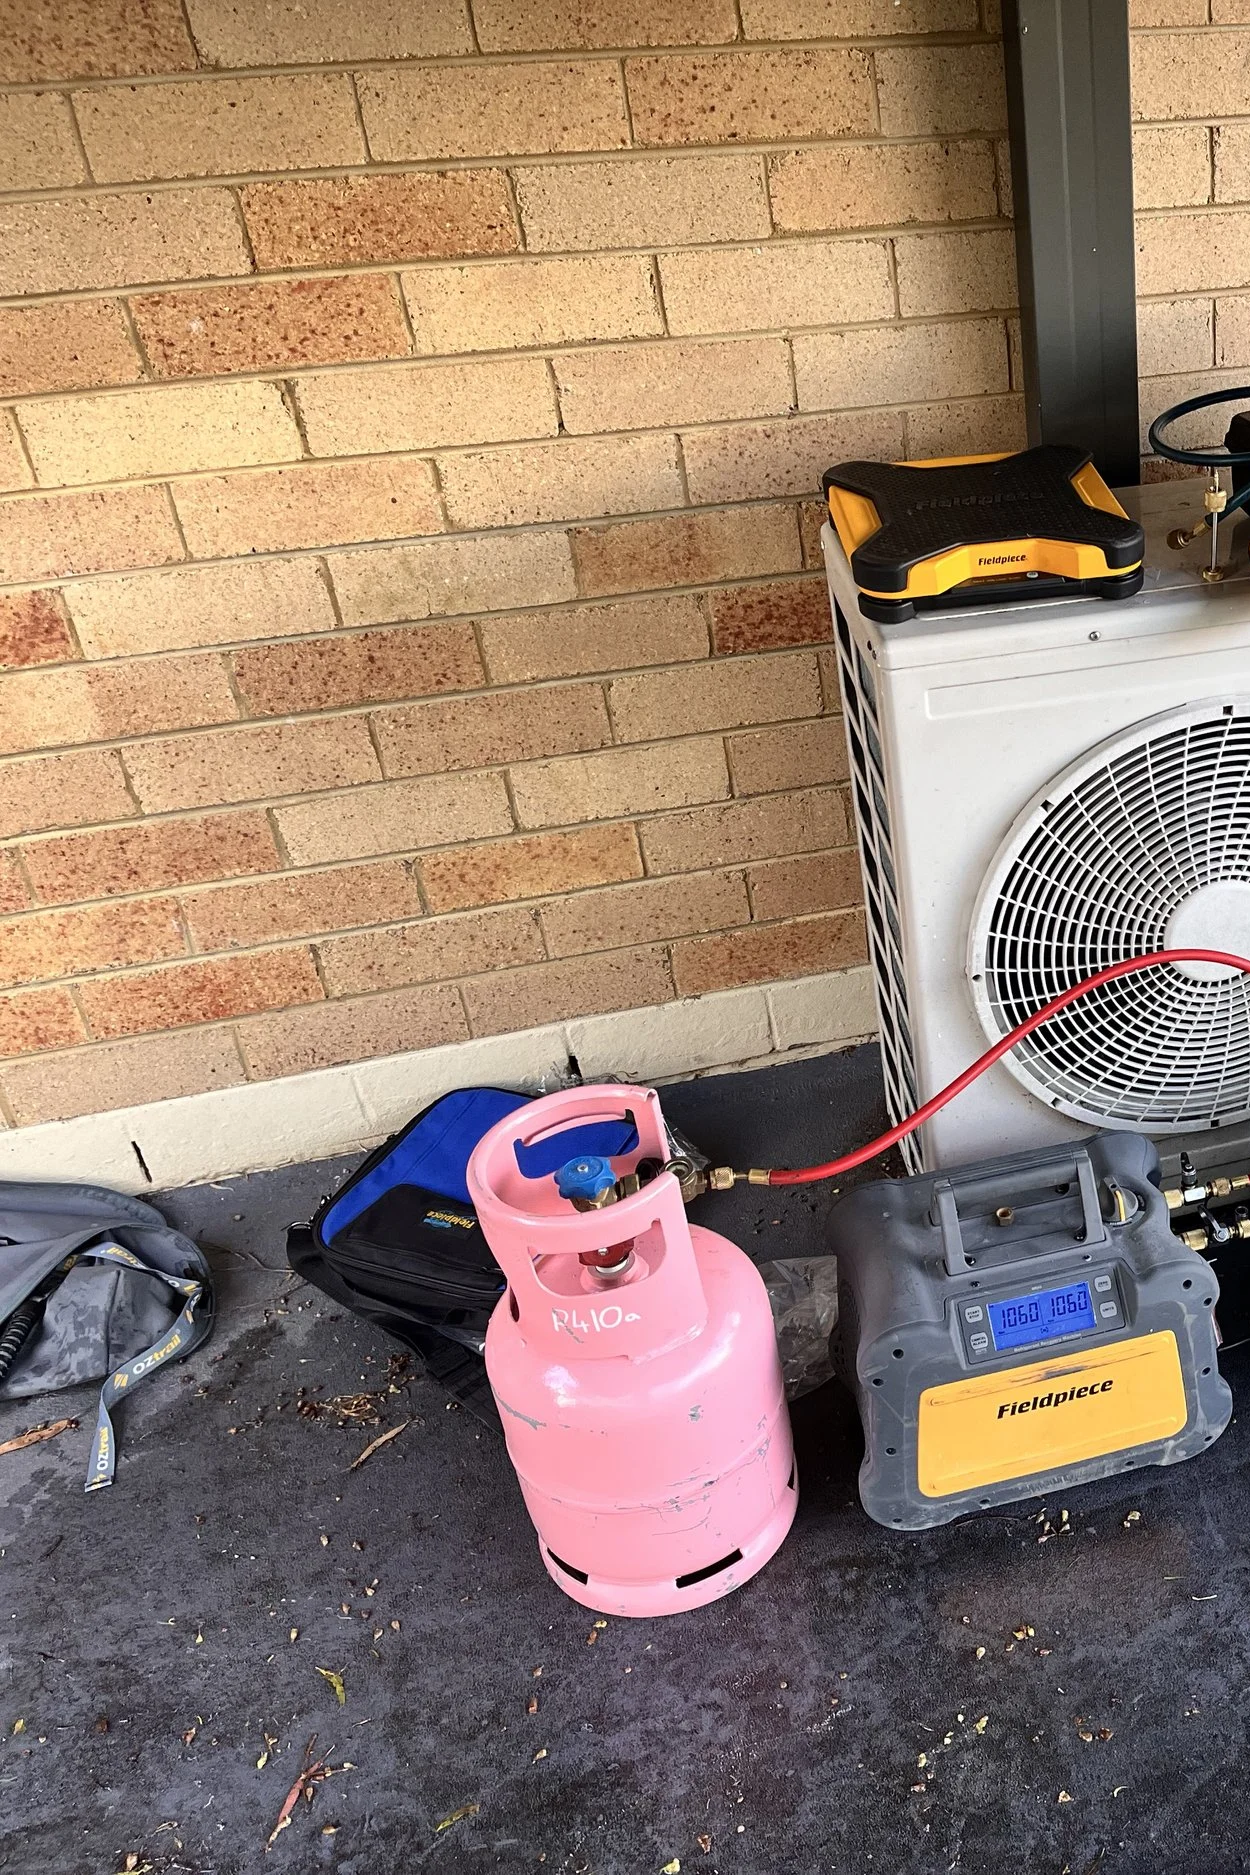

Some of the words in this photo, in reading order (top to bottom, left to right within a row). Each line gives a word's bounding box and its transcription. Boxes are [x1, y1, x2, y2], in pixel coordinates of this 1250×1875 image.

[978, 554, 1027, 566] Fieldpiece
[426, 1210, 476, 1229] Fieldpiece
[552, 1306, 641, 1333] R410a
[1002, 1302, 1039, 1329] 1060
[1051, 1290, 1088, 1317] 1060
[997, 1380, 1113, 1419] Fieldpiece
